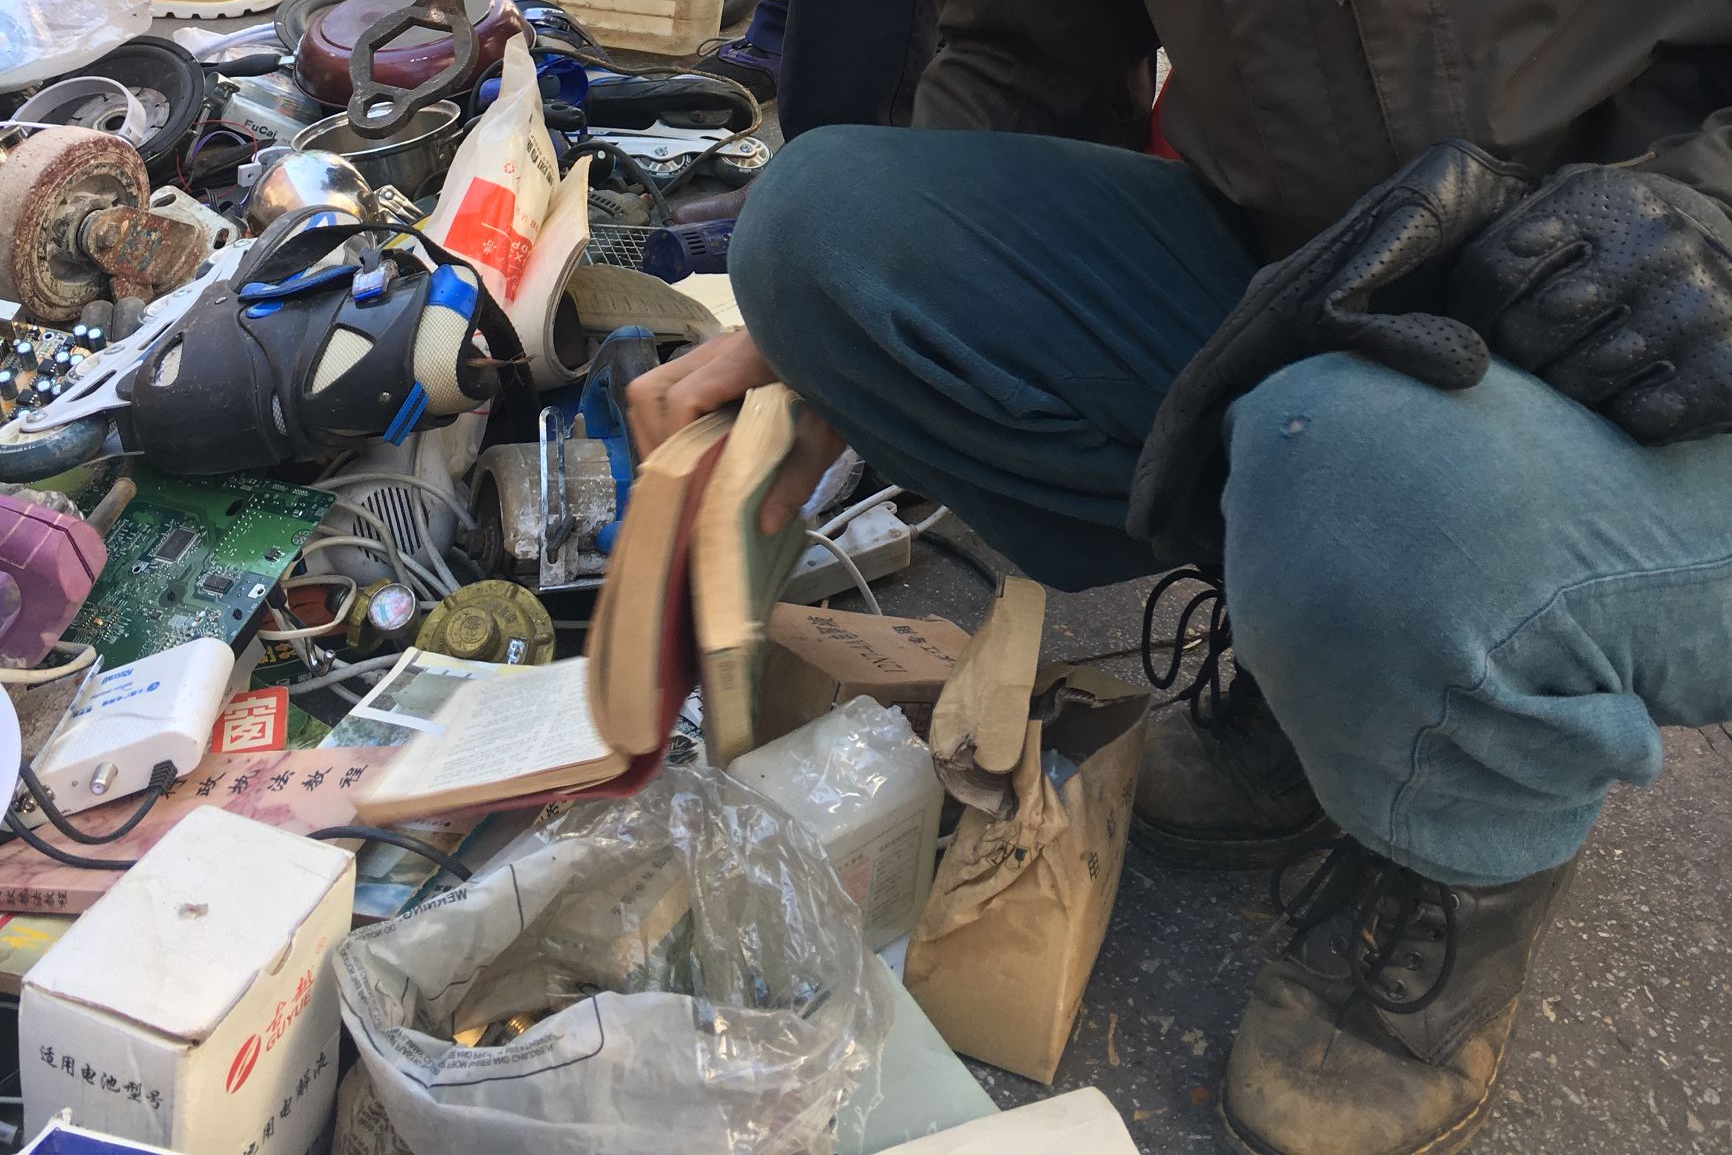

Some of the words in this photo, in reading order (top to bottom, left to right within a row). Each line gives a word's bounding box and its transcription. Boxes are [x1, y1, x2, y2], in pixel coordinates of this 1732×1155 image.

[266, 987, 312, 1052] GUYUE
[39, 1045, 164, 1110] 适用电池型号
